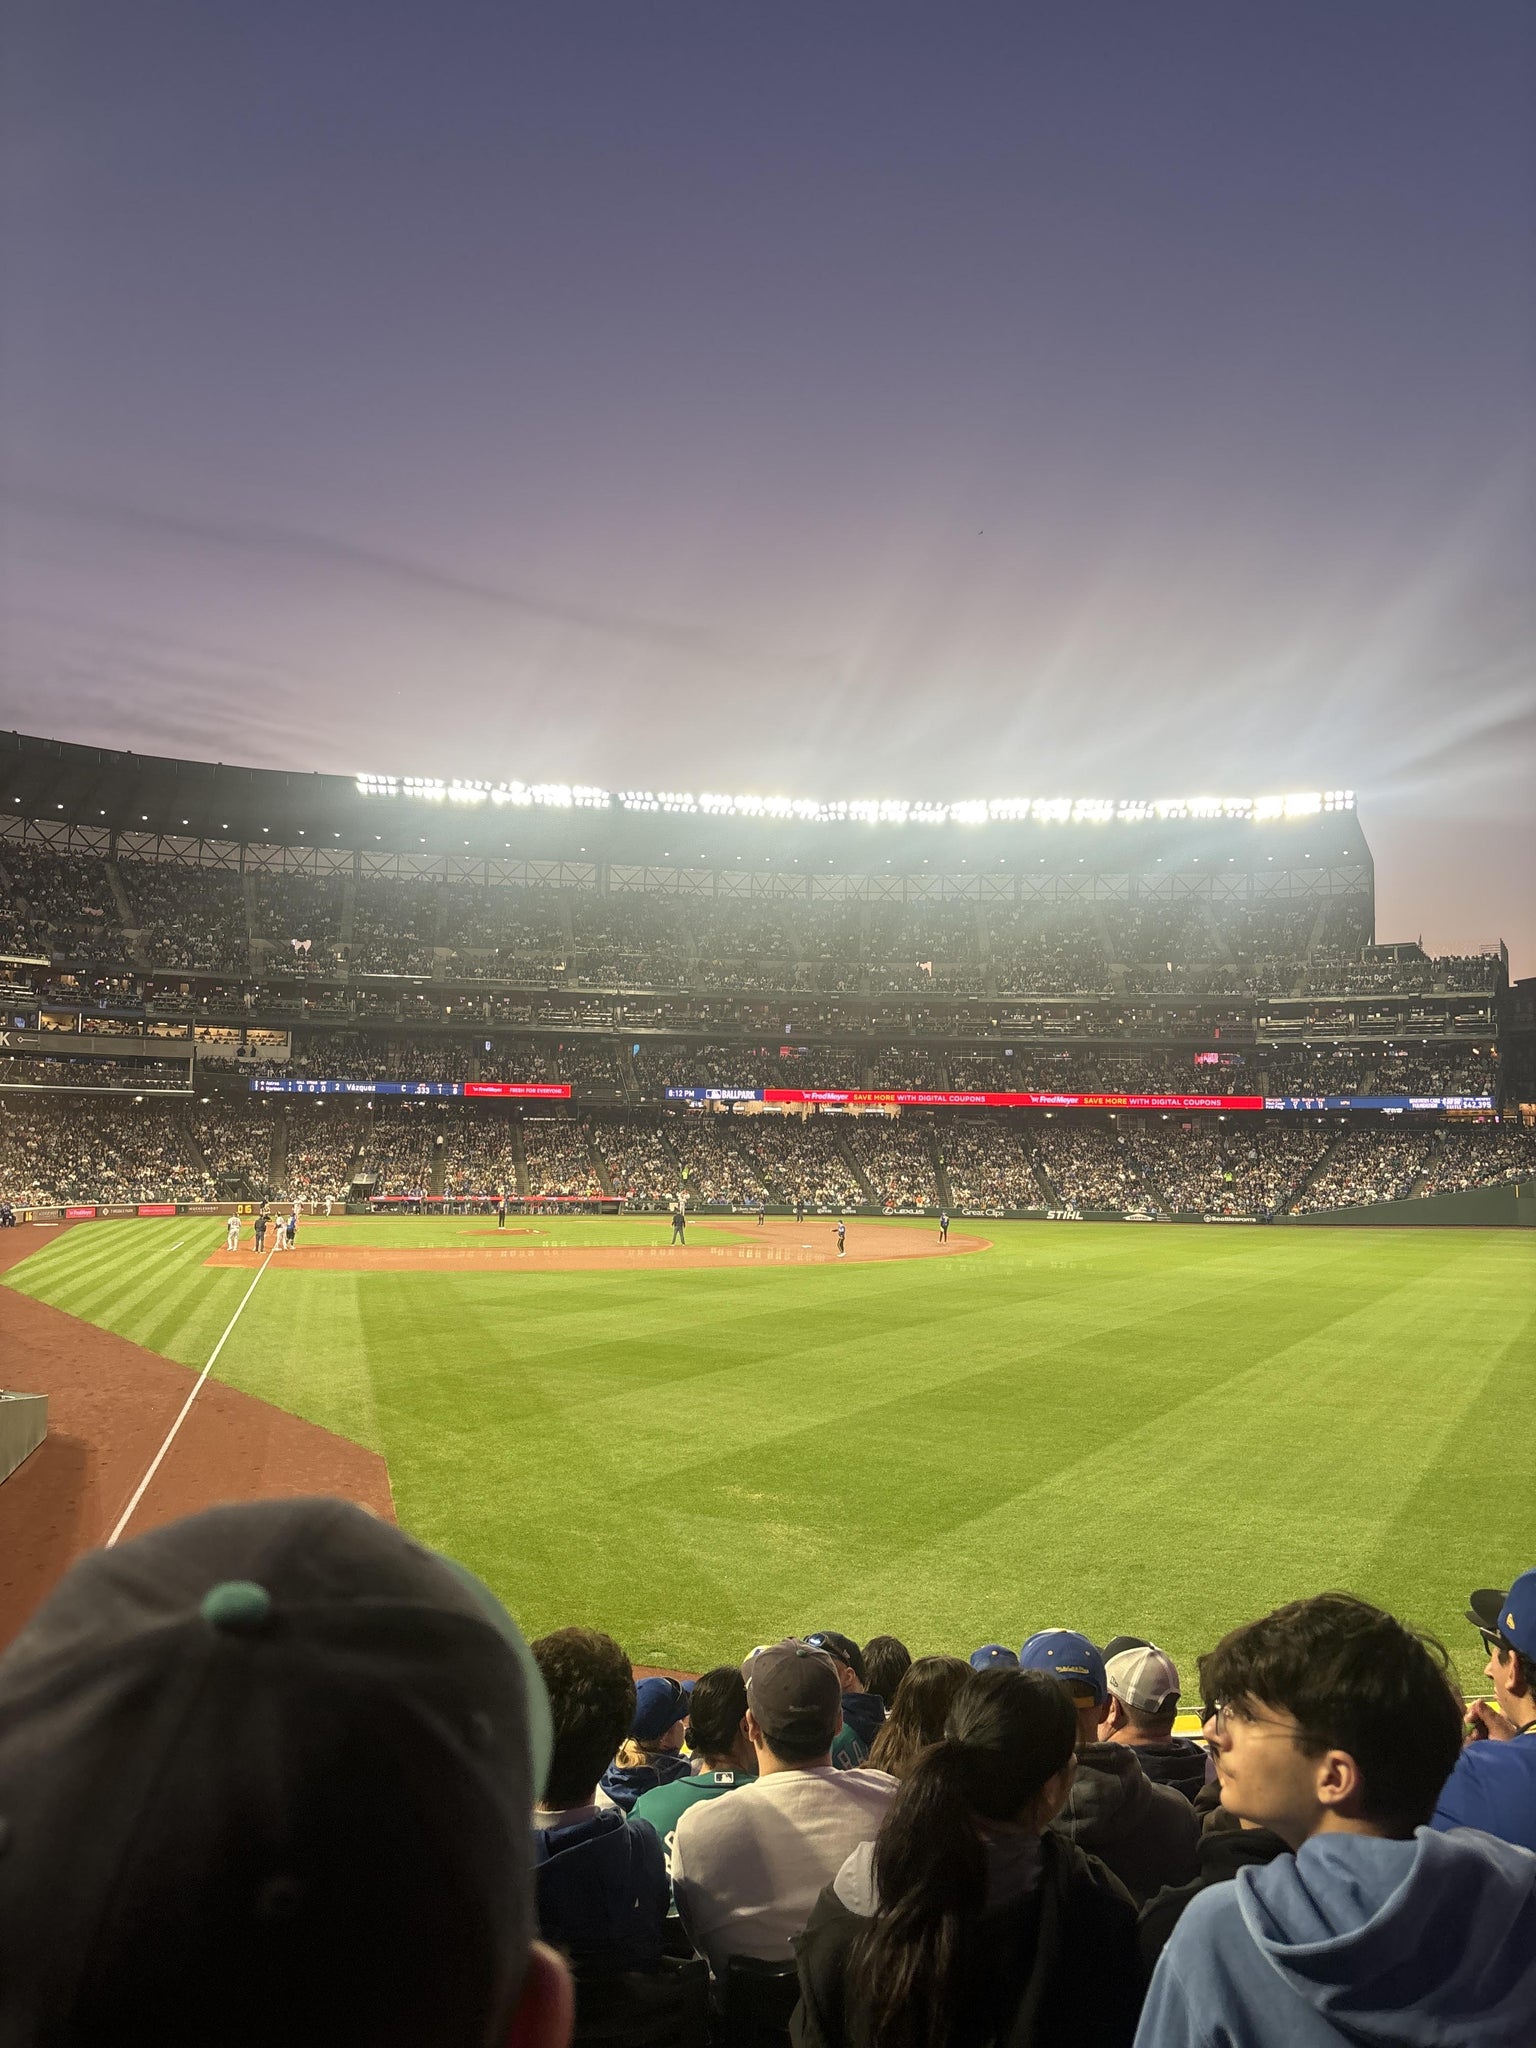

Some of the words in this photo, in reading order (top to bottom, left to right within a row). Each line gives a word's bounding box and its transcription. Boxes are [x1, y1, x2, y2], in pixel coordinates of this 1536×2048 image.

[335, 1083, 340, 1091] 2
[346, 1083, 376, 1093] Vázquez
[401, 1084, 407, 1092] C
[414, 1086, 430, 1095] .333
[684, 1090, 695, 1098] PM
[721, 1090, 756, 1100] BALLPARK
[853, 1093, 872, 1101] SAVE
[897, 1094, 917, 1102] WITH
[949, 1095, 986, 1103] COUPONS
[1083, 1097, 1103, 1105] SAVE
[1105, 1097, 1128, 1105] MORE
[1151, 1098, 1181, 1106] DIGITAL
[1183, 1099, 1222, 1107] COUPONS
[1463, 1101, 1492, 1109] $42,395
[237, 1205, 252, 1214] 06
[961, 1208, 984, 1216] Great
[985, 1209, 1005, 1217] Clips
[1046, 1210, 1084, 1220] STIHL
